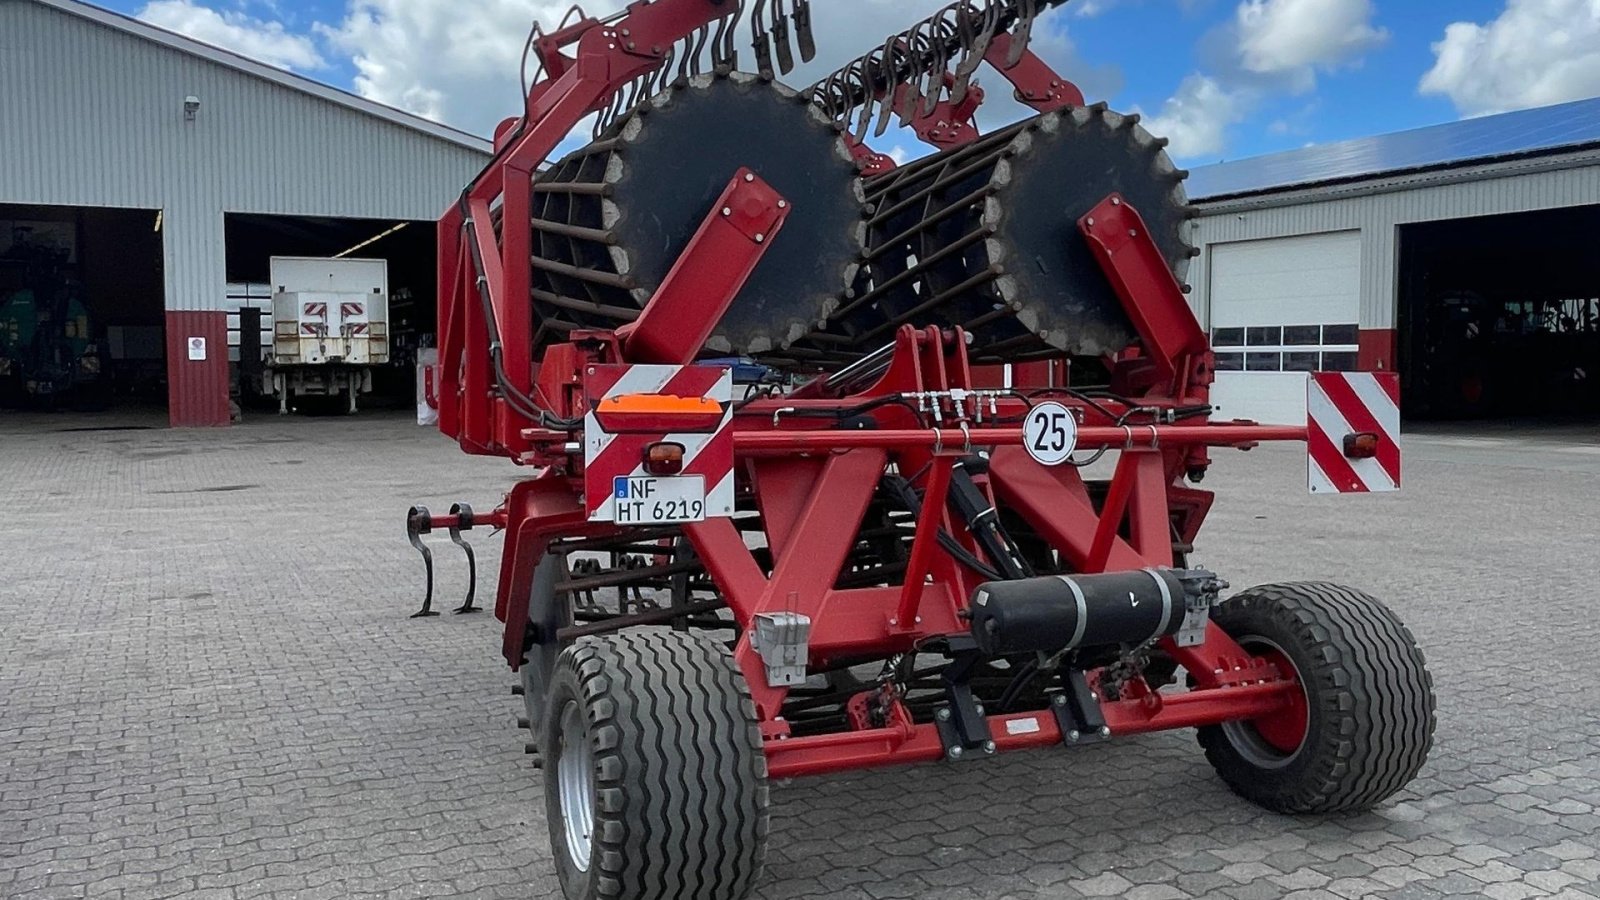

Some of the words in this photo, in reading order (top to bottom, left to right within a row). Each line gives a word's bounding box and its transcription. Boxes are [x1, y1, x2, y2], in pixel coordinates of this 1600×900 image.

[1034, 412, 1066, 452] 25
[631, 479, 657, 499] NF
[618, 502, 645, 521] HT
[652, 500, 703, 520] 6219
